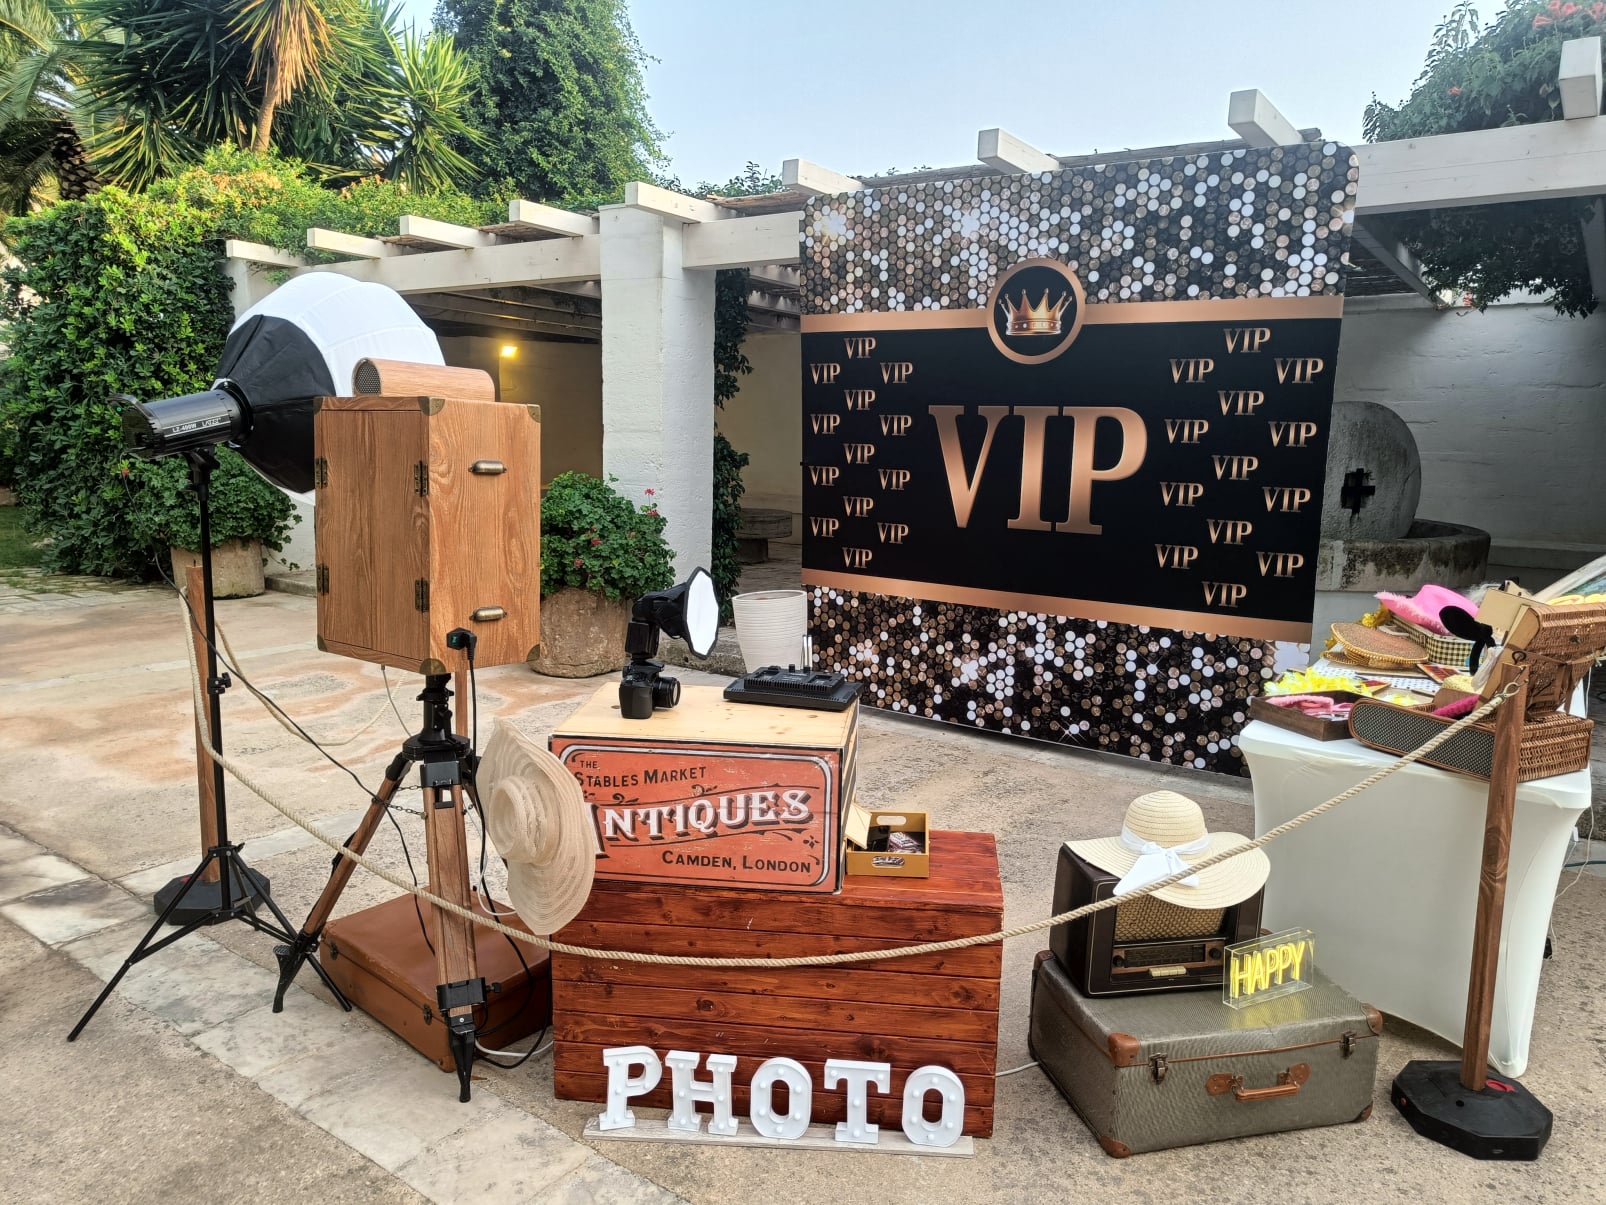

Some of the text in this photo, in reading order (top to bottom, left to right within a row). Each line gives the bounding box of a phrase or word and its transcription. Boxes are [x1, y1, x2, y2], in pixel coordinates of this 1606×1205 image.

[845, 336, 876, 359] VIP
[1222, 327, 1270, 354] VIP
[810, 362, 840, 385] VIP
[880, 361, 913, 384] VIP
[1168, 358, 1214, 384] VIP
[1274, 357, 1323, 384] VIP
[845, 389, 875, 411] VIP
[1217, 390, 1264, 416] VIP
[811, 413, 840, 435] VIP
[879, 414, 911, 436] VIP
[1164, 419, 1208, 444] VIP
[1268, 421, 1316, 447] VIP
[844, 443, 874, 465] VIP
[810, 465, 839, 486] VIP
[879, 469, 910, 491] VIP
[929, 405, 1147, 534] VIP
[1212, 455, 1258, 481] VIP
[843, 496, 873, 517] VIP
[1159, 482, 1203, 507] VIP
[1262, 487, 1310, 512] VIP
[811, 517, 839, 538] VIP
[877, 522, 908, 544] VIP
[1206, 519, 1252, 545] VIP
[843, 547, 872, 569] VIP
[1154, 543, 1198, 569] VIP
[1256, 553, 1303, 577] VIP
[1202, 583, 1246, 607] VIP
[579, 760, 598, 769] THE
[574, 766, 707, 788] STABLES MARKET
[662, 850, 811, 874] CAMDEN, LONDON
[1230, 940, 1306, 999] HAPPY
[598, 1045, 966, 1148] PHOTO
